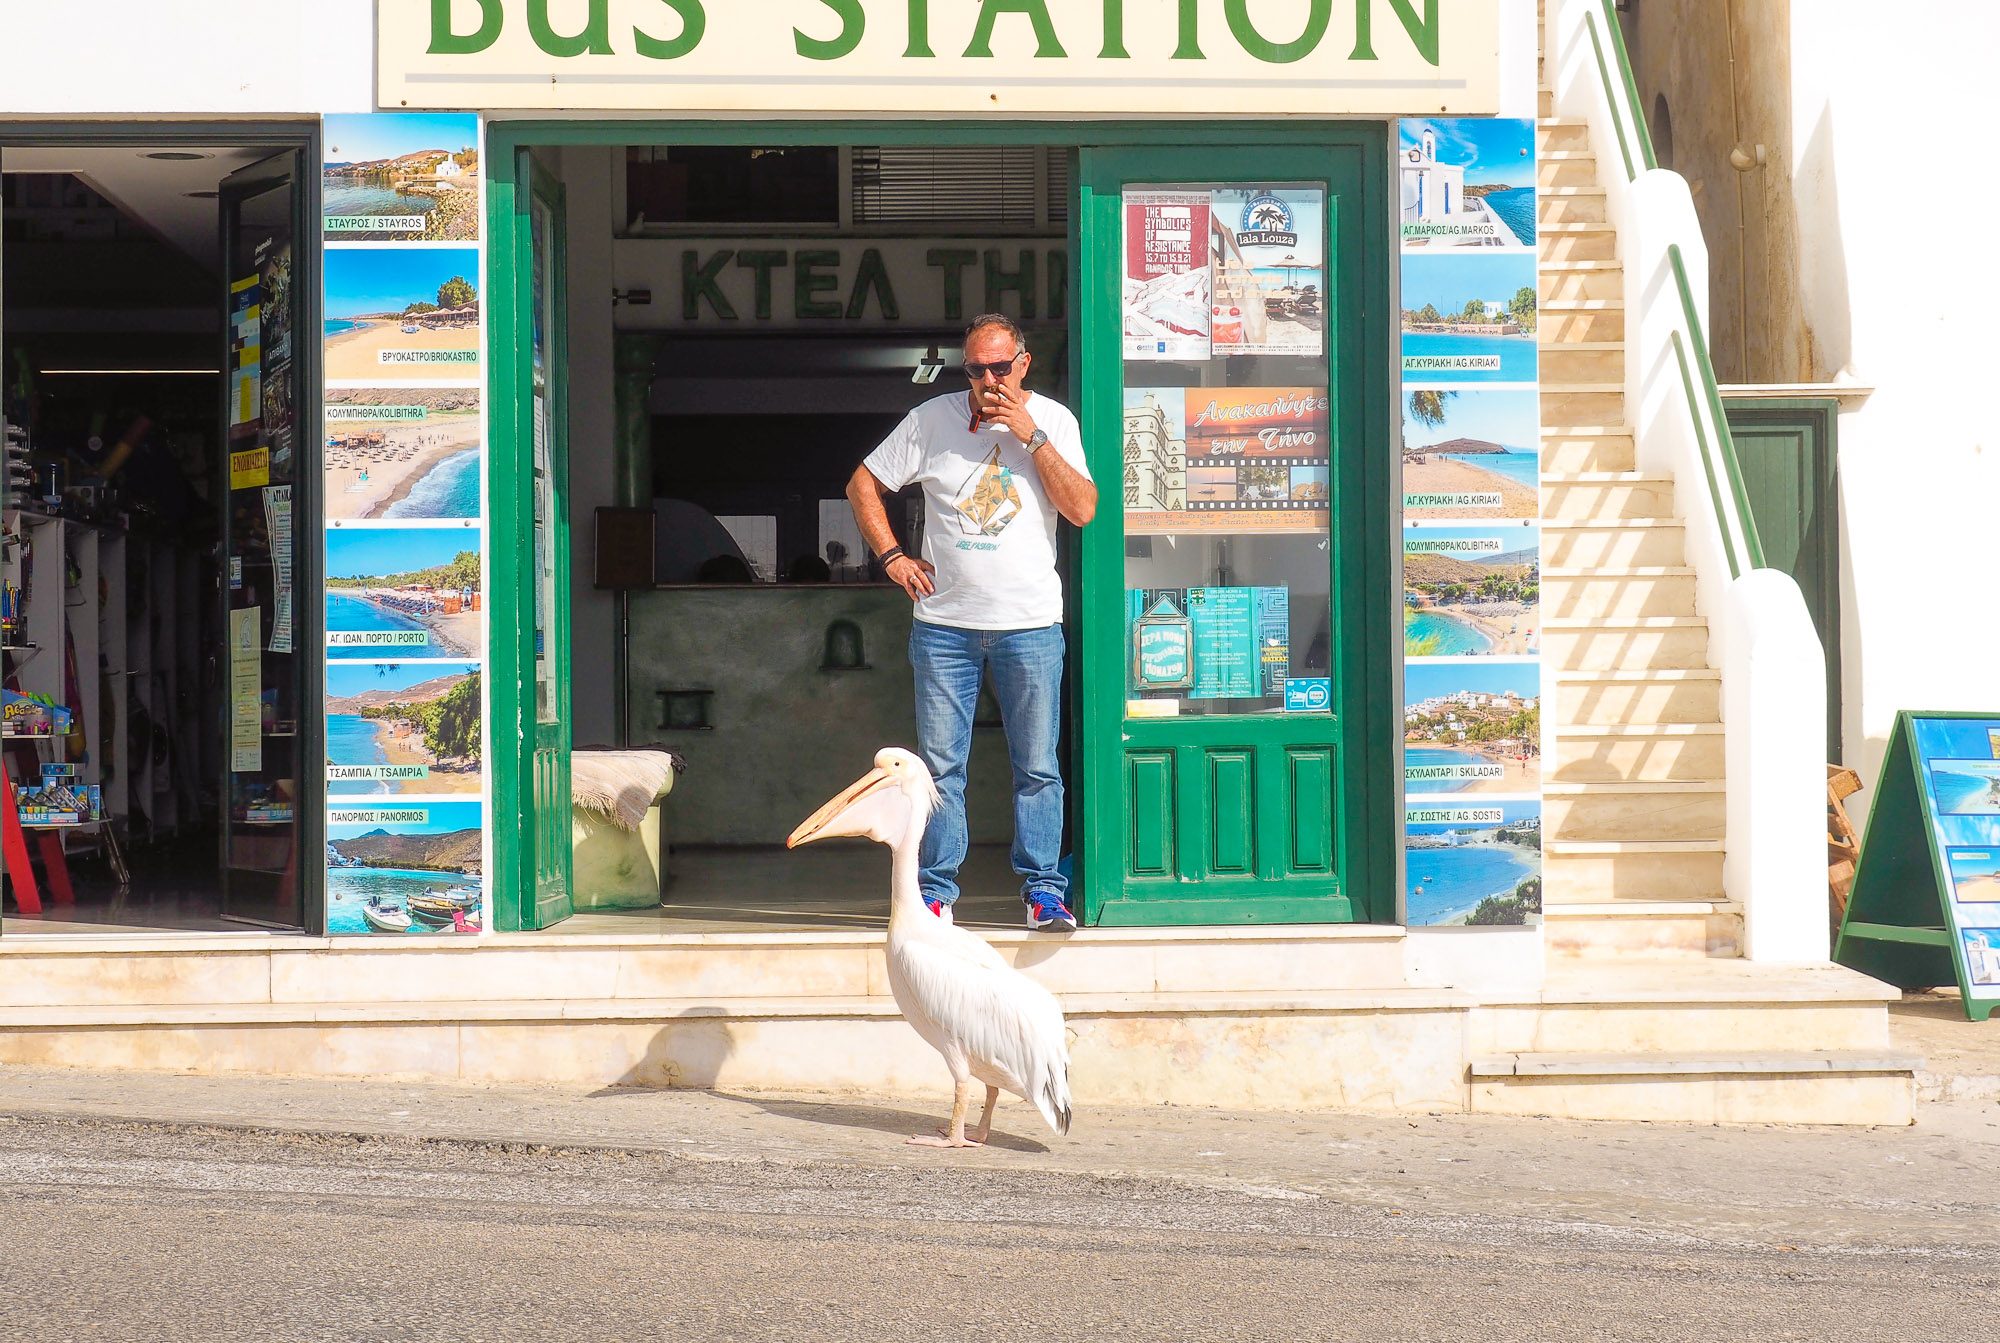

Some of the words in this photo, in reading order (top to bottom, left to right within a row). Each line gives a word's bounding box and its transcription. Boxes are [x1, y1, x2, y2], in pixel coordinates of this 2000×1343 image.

[1145, 207, 1160, 218] THE
[328, 218, 370, 229] ΣΤΑΥΡΟΣ
[378, 218, 422, 228] STAYROS
[1145, 230, 1155, 241] OF
[1239, 234, 1259, 245] lala
[1261, 233, 1294, 245] Louza
[1145, 241, 1191, 253] RESISTANCE
[1159, 253, 1168, 263] TO
[682, 249, 899, 320] ΚΤΕΛ
[382, 351, 477, 362] ΒΡΥΟΚΑΣΤΡΟ/BRIOKASTRO
[1405, 358, 1452, 368] ΑΓ.ΚΥΡΙΑΚΗ
[327, 408, 423, 418] ΚΟΛΥΜΠΗΘΡΑ/KOLIBITHRA
[1211, 438, 1249, 456] την
[1258, 427, 1316, 451] Τήνο
[1406, 495, 1454, 506] ΑΓ.ΚΥΡΙΑΚΗ
[330, 634, 342, 644] ΑΓ.
[366, 633, 392, 643] ΠΟΡΤΟ
[398, 633, 424, 643] PORTO
[329, 768, 372, 778] ΤΣΑΜΠΙΑ
[380, 767, 423, 777] TSAMPIA
[1405, 769, 1454, 779] ΣΚΥΛΑΝΤΑΡΙ
[1460, 767, 1503, 777] SKILADARI
[331, 812, 375, 822] ΠΑΝΟΡΜΟΣ
[380, 811, 424, 822] PANORMOS
[1406, 812, 1419, 822] ΑΓ.
[1420, 811, 1451, 821] ΣΩΣΤΗΣ
[1457, 811, 1471, 821] AG.
[1473, 810, 1502, 820] SOSTIS
